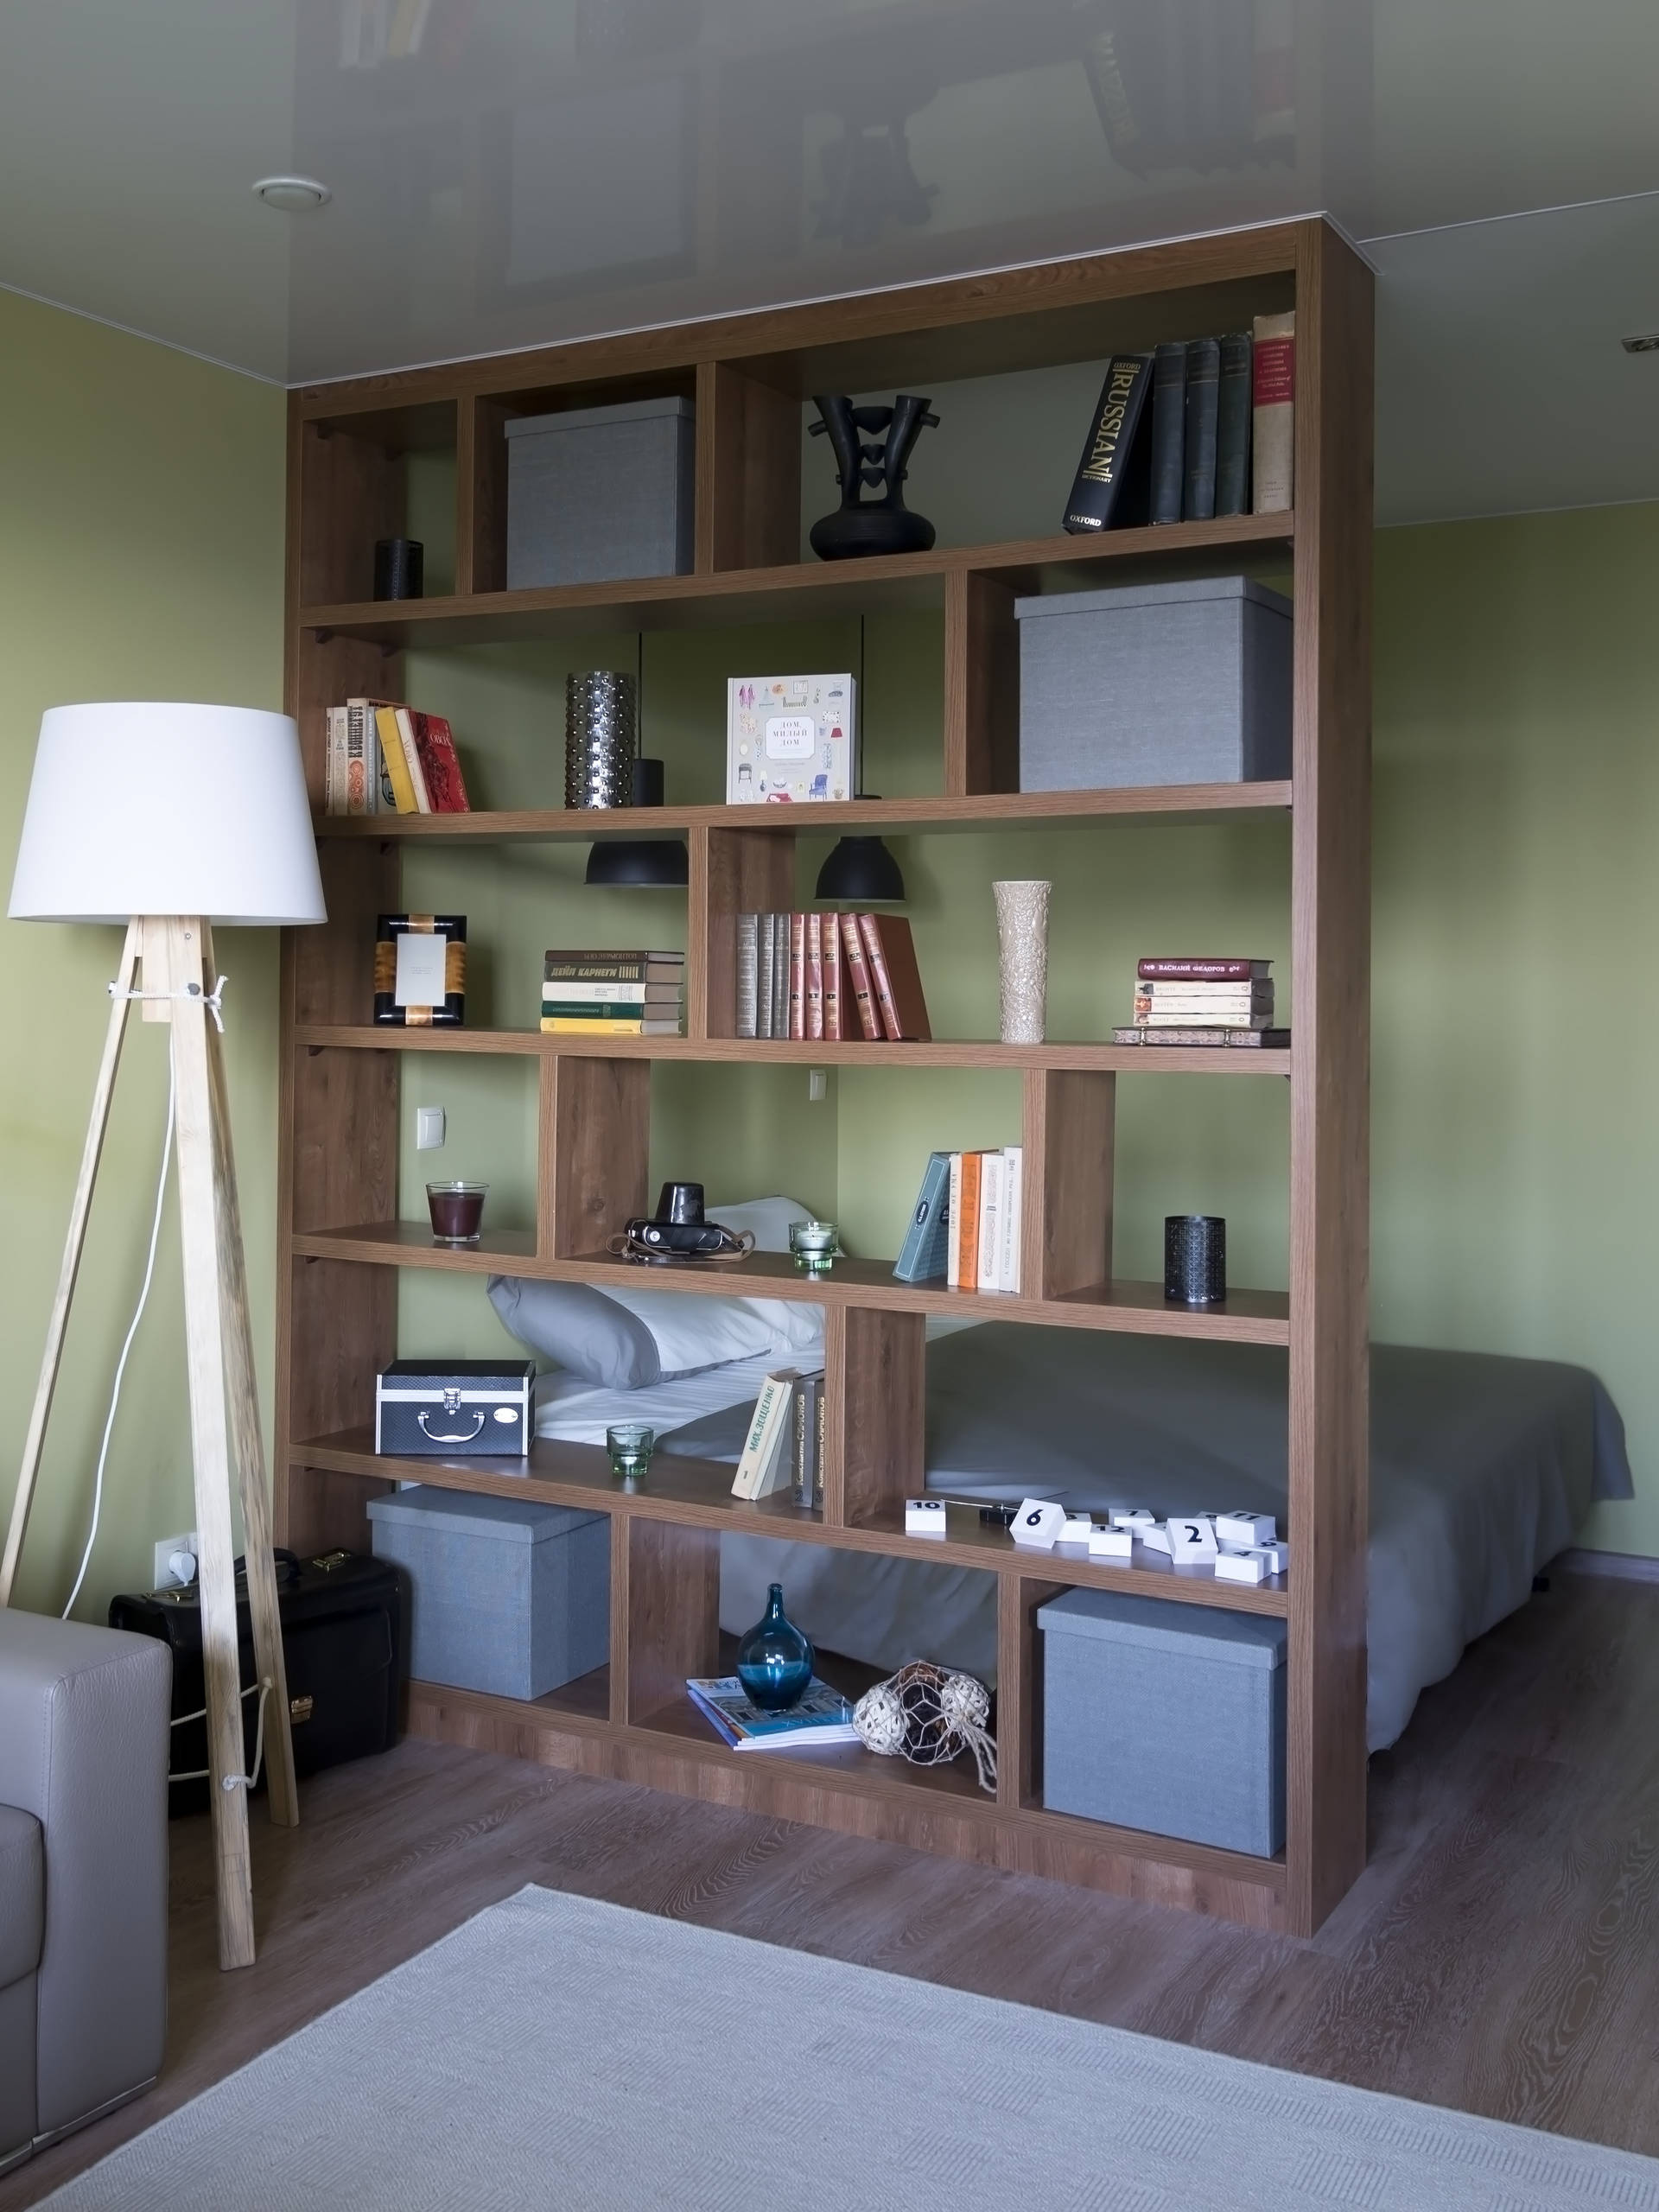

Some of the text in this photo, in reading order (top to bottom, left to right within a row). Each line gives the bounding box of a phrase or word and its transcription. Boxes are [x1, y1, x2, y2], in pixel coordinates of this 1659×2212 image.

[1088, 373, 1135, 474] RUSSIAN
[1081, 474, 1112, 483] DICTIONARY
[1070, 514, 1102, 526] OXFORD
[781, 739, 799, 747] ДОМ
[551, 965, 618, 976] ДЕЙЛ КАРНЕГИ
[797, 1394, 805, 1440] СИМОНОВ
[742, 1471, 748, 1479] 1
[912, 1501, 940, 1510] 10
[1026, 1509, 1044, 1526] 6
[1185, 1525, 1203, 1542] 2
